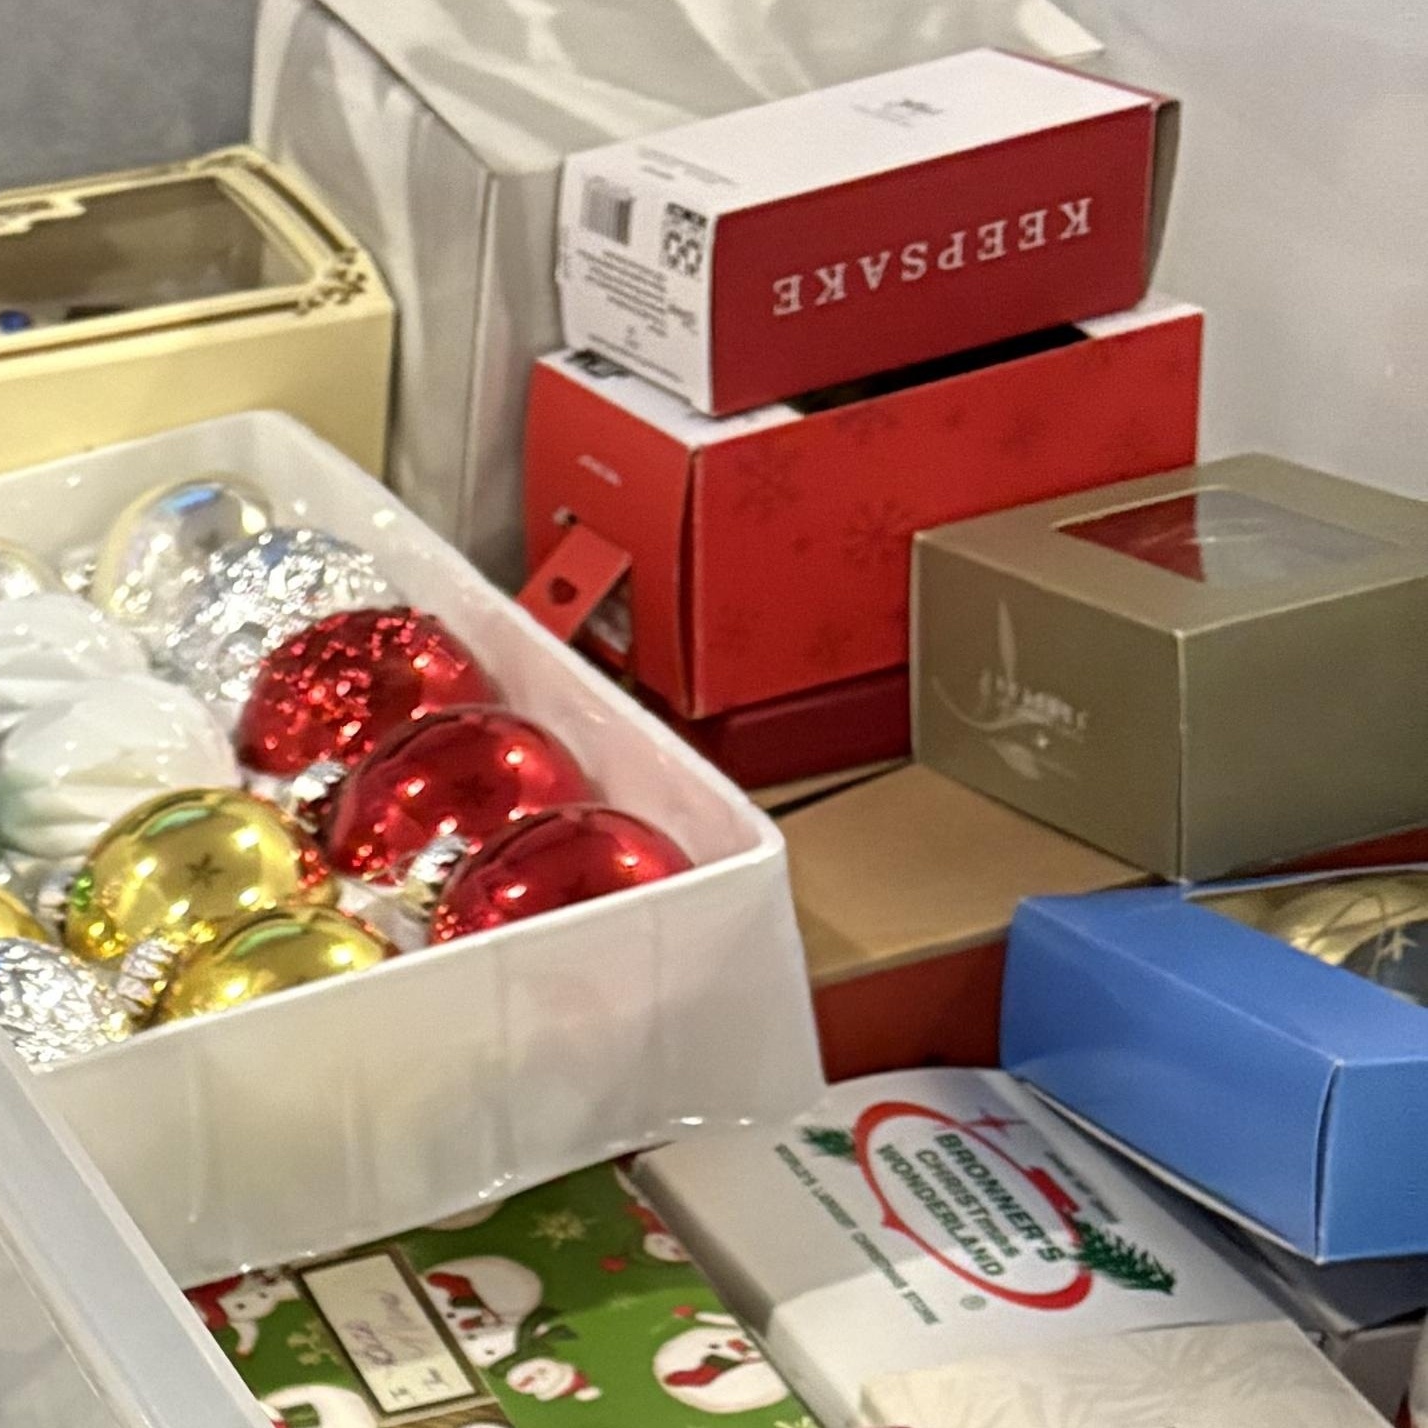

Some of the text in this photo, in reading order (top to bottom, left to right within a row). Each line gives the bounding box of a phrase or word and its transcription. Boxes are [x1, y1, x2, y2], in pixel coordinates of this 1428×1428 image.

[772, 198, 1093, 316] KEEPSAKE
[877, 1144, 1004, 1275] WONDERLAND
[935, 1133, 1065, 1261] BRONNER'S
